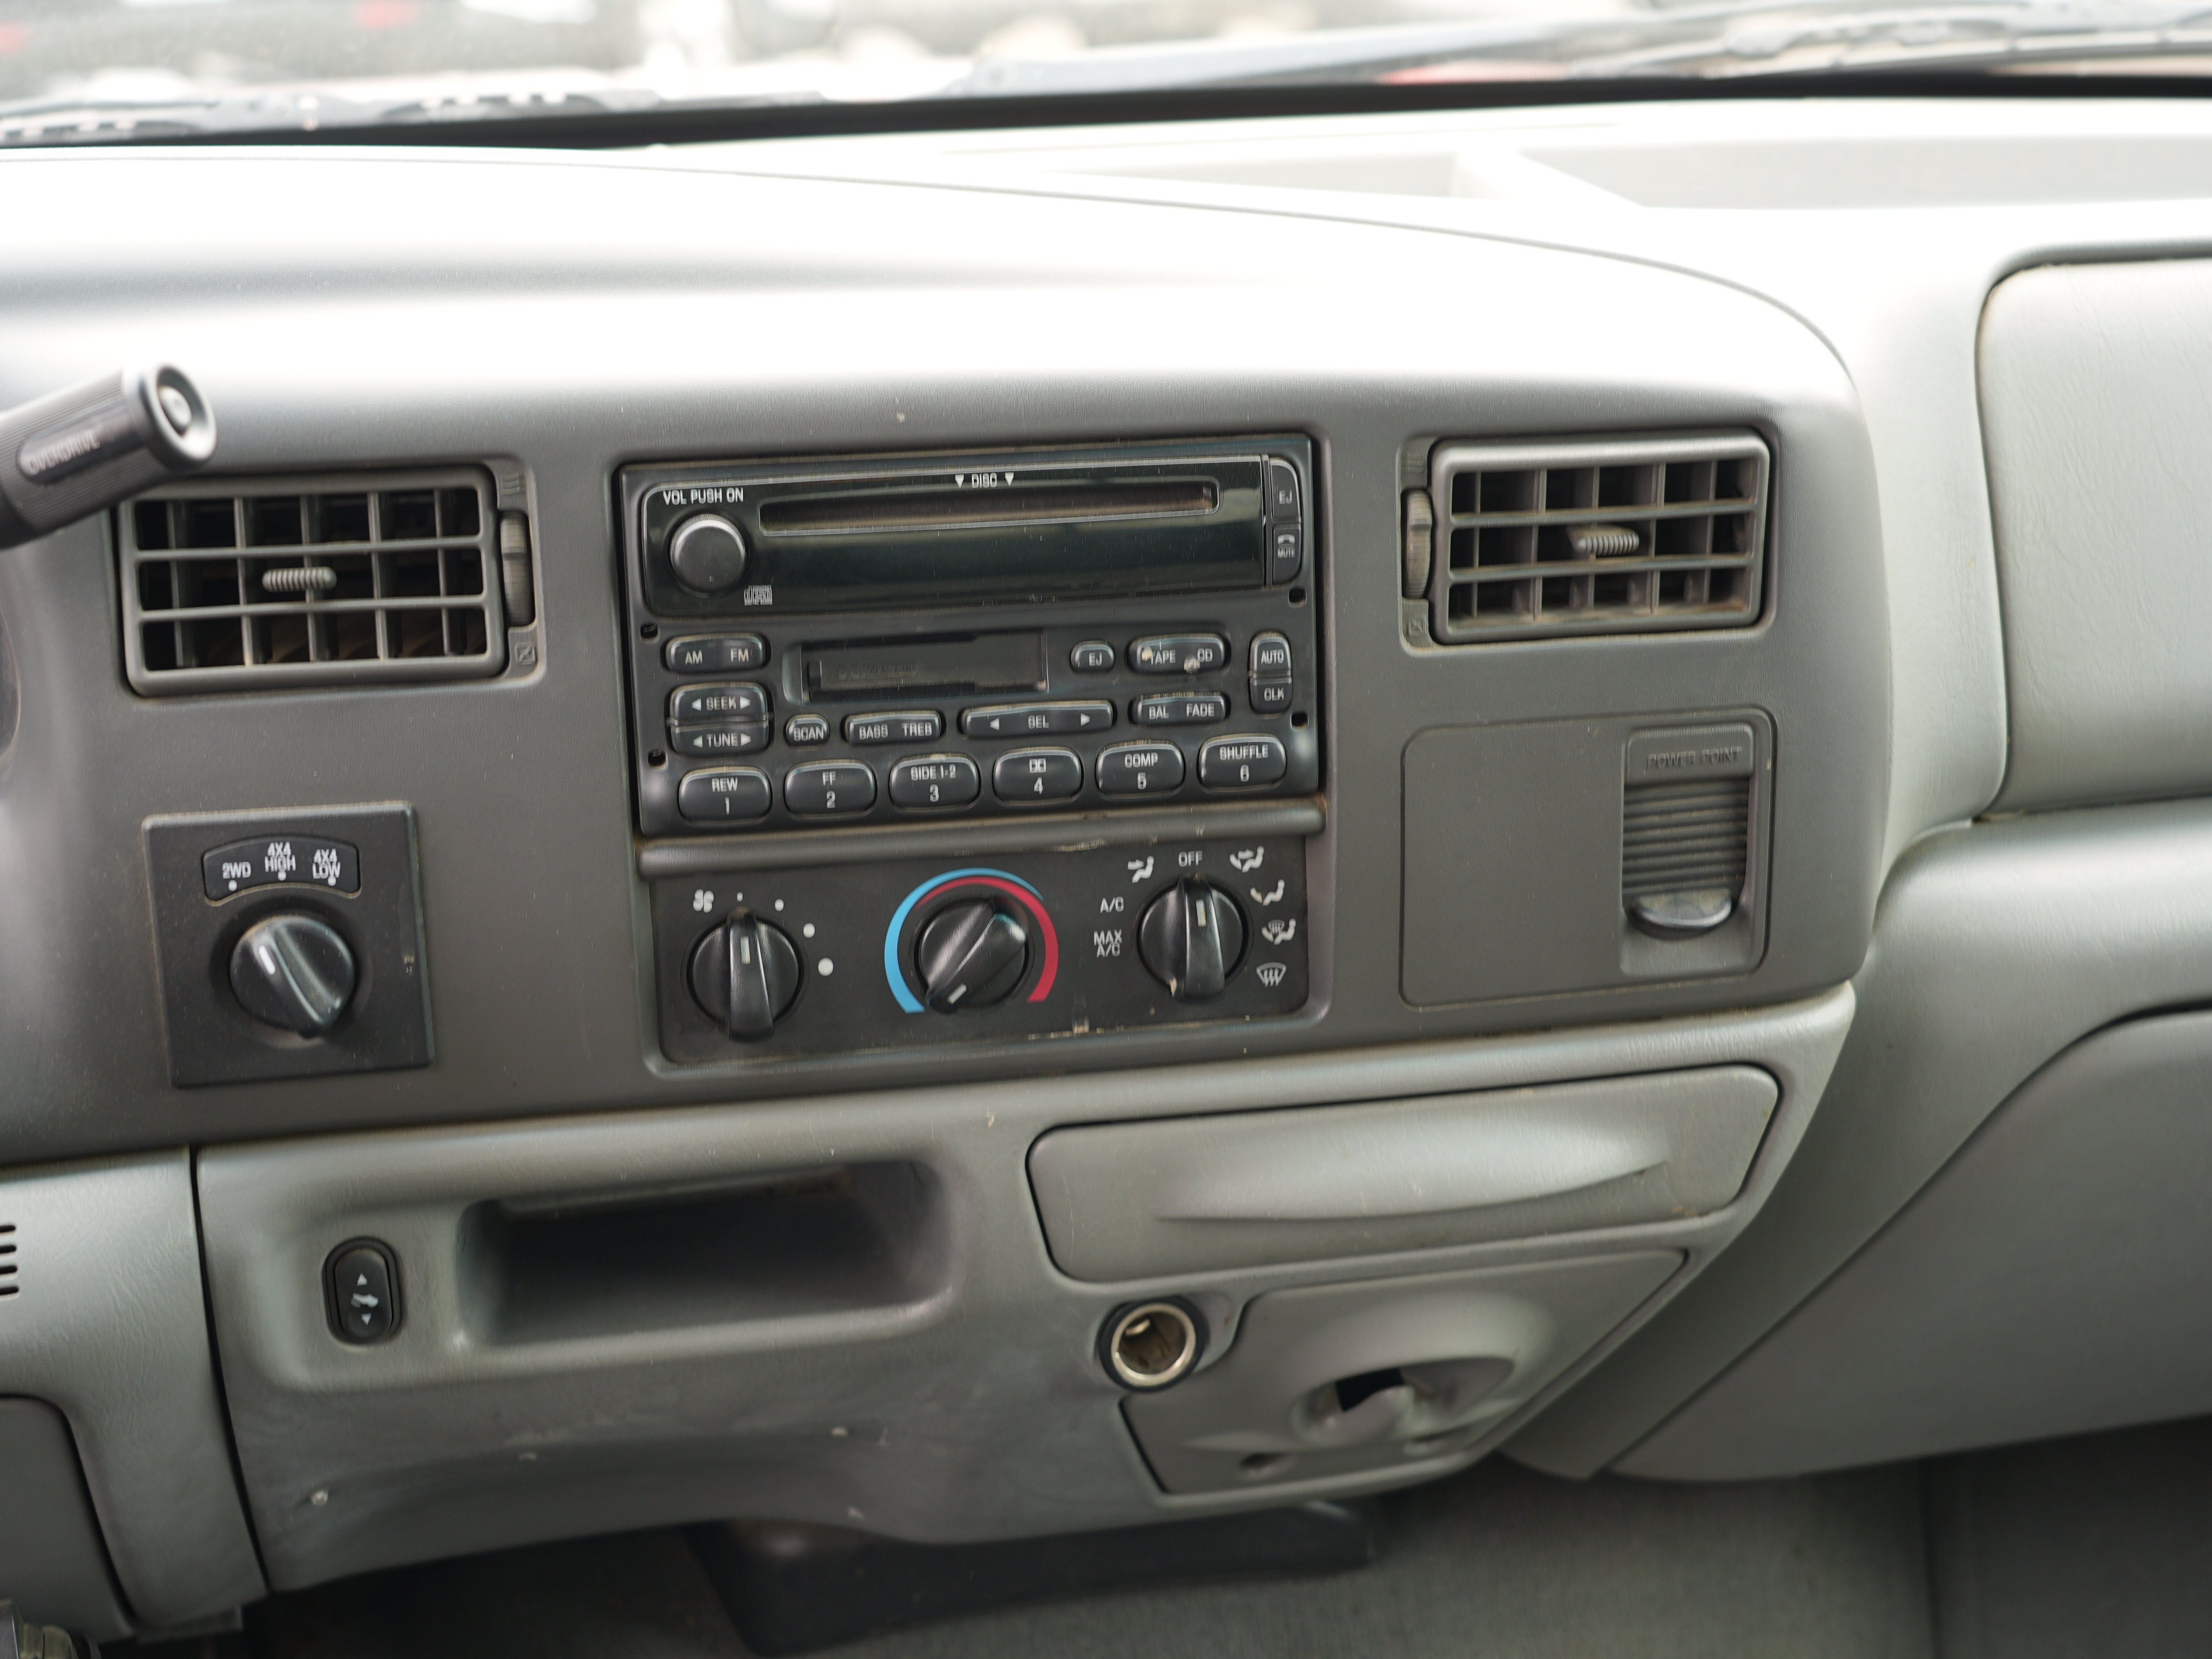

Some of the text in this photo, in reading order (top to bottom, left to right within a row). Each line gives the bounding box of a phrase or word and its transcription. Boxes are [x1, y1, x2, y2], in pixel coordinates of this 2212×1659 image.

[972, 473, 997, 488] DISC
[663, 487, 744, 505] VOL PUSH ON
[1279, 489, 1292, 504] EJ
[1277, 548, 1296, 558] MUTE
[685, 650, 703, 665] AM
[731, 648, 749, 663] FM
[1089, 652, 1102, 666] EJ
[1150, 649, 1176, 665] TAPE
[1197, 648, 1213, 662] CD
[1261, 649, 1284, 665] AUTO
[1264, 686, 1284, 702] CLK
[706, 696, 737, 711] SEEK
[1186, 703, 1215, 718] FADE
[1149, 704, 1169, 720] BAL
[901, 721, 933, 737] TREB
[1028, 714, 1049, 730] SEL
[706, 732, 738, 748] TUNE
[793, 726, 824, 741] SCAN
[859, 724, 888, 740] BASS
[1124, 751, 1158, 768] COMP
[1219, 744, 1269, 760] SHUFFLE
[1647, 746, 1741, 768] POWER POINT
[822, 771, 836, 785] FF
[911, 765, 936, 781] SIDE
[1137, 772, 1147, 790] 5
[1240, 764, 1250, 783] 6
[712, 777, 738, 792] REW
[1034, 776, 1043, 795] 4
[826, 790, 836, 809] 2
[929, 784, 939, 802] 3
[725, 797, 731, 814] 1
[267, 841, 291, 857] 4X4
[313, 848, 337, 864] 4X4
[265, 855, 296, 873] HIGH
[1178, 851, 1202, 866] OFF
[222, 861, 251, 879] 2WD
[312, 862, 341, 879] LOW
[1100, 896, 1124, 913] A/C
[1094, 929, 1122, 945] MAX
[1096, 943, 1120, 957] A/C
